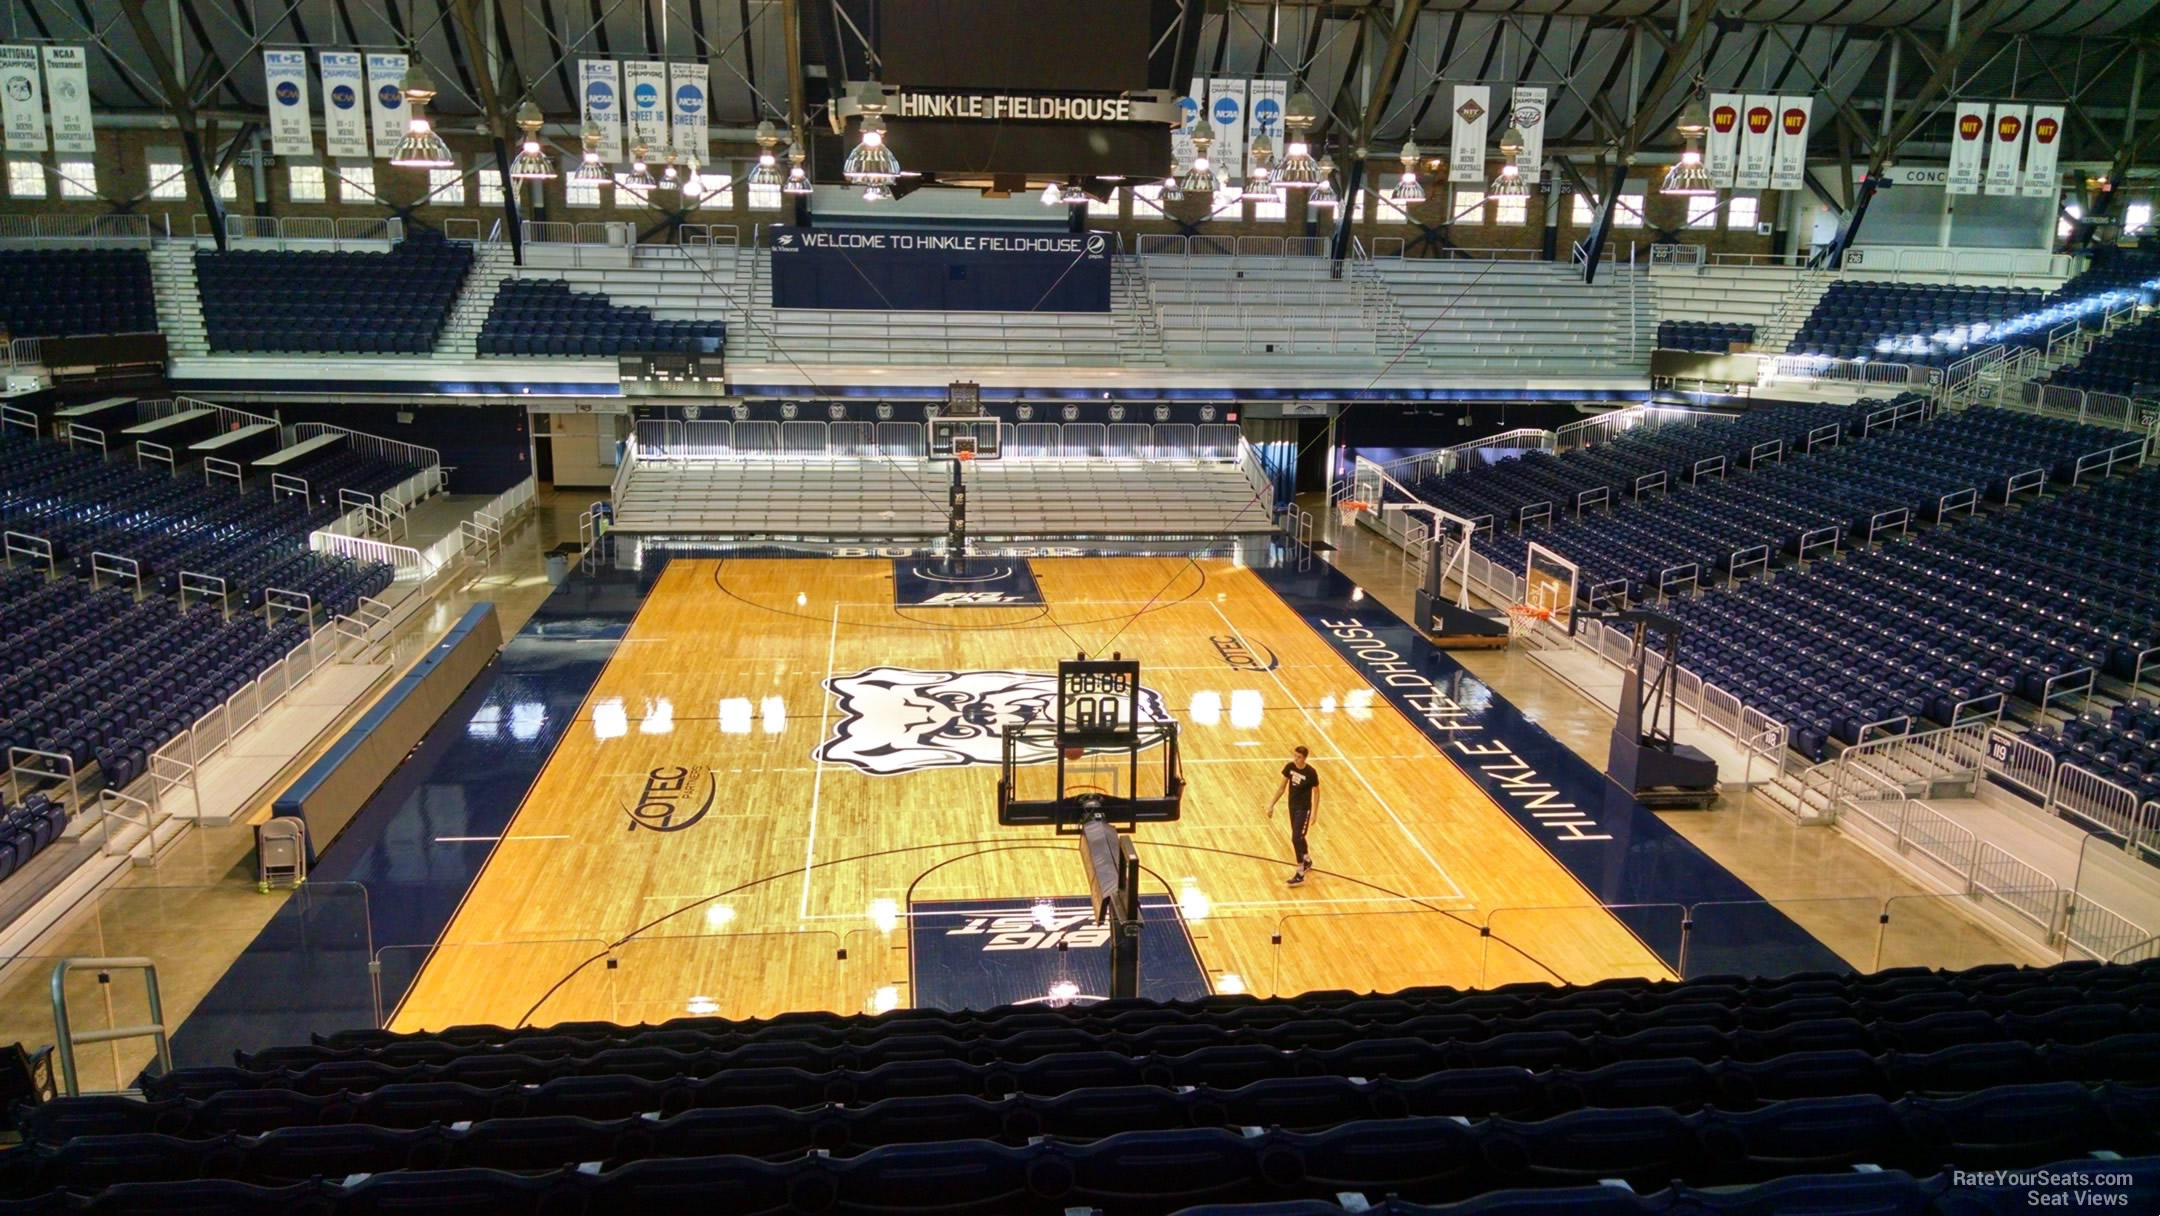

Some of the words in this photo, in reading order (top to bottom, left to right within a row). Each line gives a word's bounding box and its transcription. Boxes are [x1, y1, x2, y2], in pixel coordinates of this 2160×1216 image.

[53, 49, 75, 58] NCAA
[628, 71, 663, 79] CHAMPIONS
[588, 95, 612, 103] NCAA
[637, 95, 657, 103] NCAA
[679, 98, 702, 106] NCAA
[901, 94, 982, 117] HINKLE
[994, 96, 1129, 120] FIELDHOUSE
[630, 111, 652, 121] SWEET
[656, 111, 664, 121] 16
[674, 114, 697, 125] SWEET
[700, 116, 706, 126] 16
[1216, 110, 1238, 118] NCAA
[1519, 111, 1536, 119] NIT
[1716, 113, 1732, 125] NIT
[1750, 114, 1768, 126] NIT
[1785, 116, 1802, 127] NIT
[1962, 121, 1978, 133] NIT
[2000, 123, 2017, 134] NIT
[2038, 125, 2053, 136] NIT
[802, 233, 885, 248] WELCOME
[890, 235, 913, 249] TO
[917, 236, 976, 250] HINKLE
[979, 238, 1081, 252] FIELDHOUSE
[832, 547, 1085, 557] BUTLER
[1320, 617, 1484, 730] FIELDHOUSE
[1765, 733, 1777, 747] 118
[1992, 733, 2012, 747] SECTION
[1993, 743, 2007, 761] 119
[682, 765, 703, 799] PARTNERS
[1454, 739, 1614, 841] HINKLE
[628, 767, 688, 832] ZOTEC
[982, 930, 1111, 951] BIG
